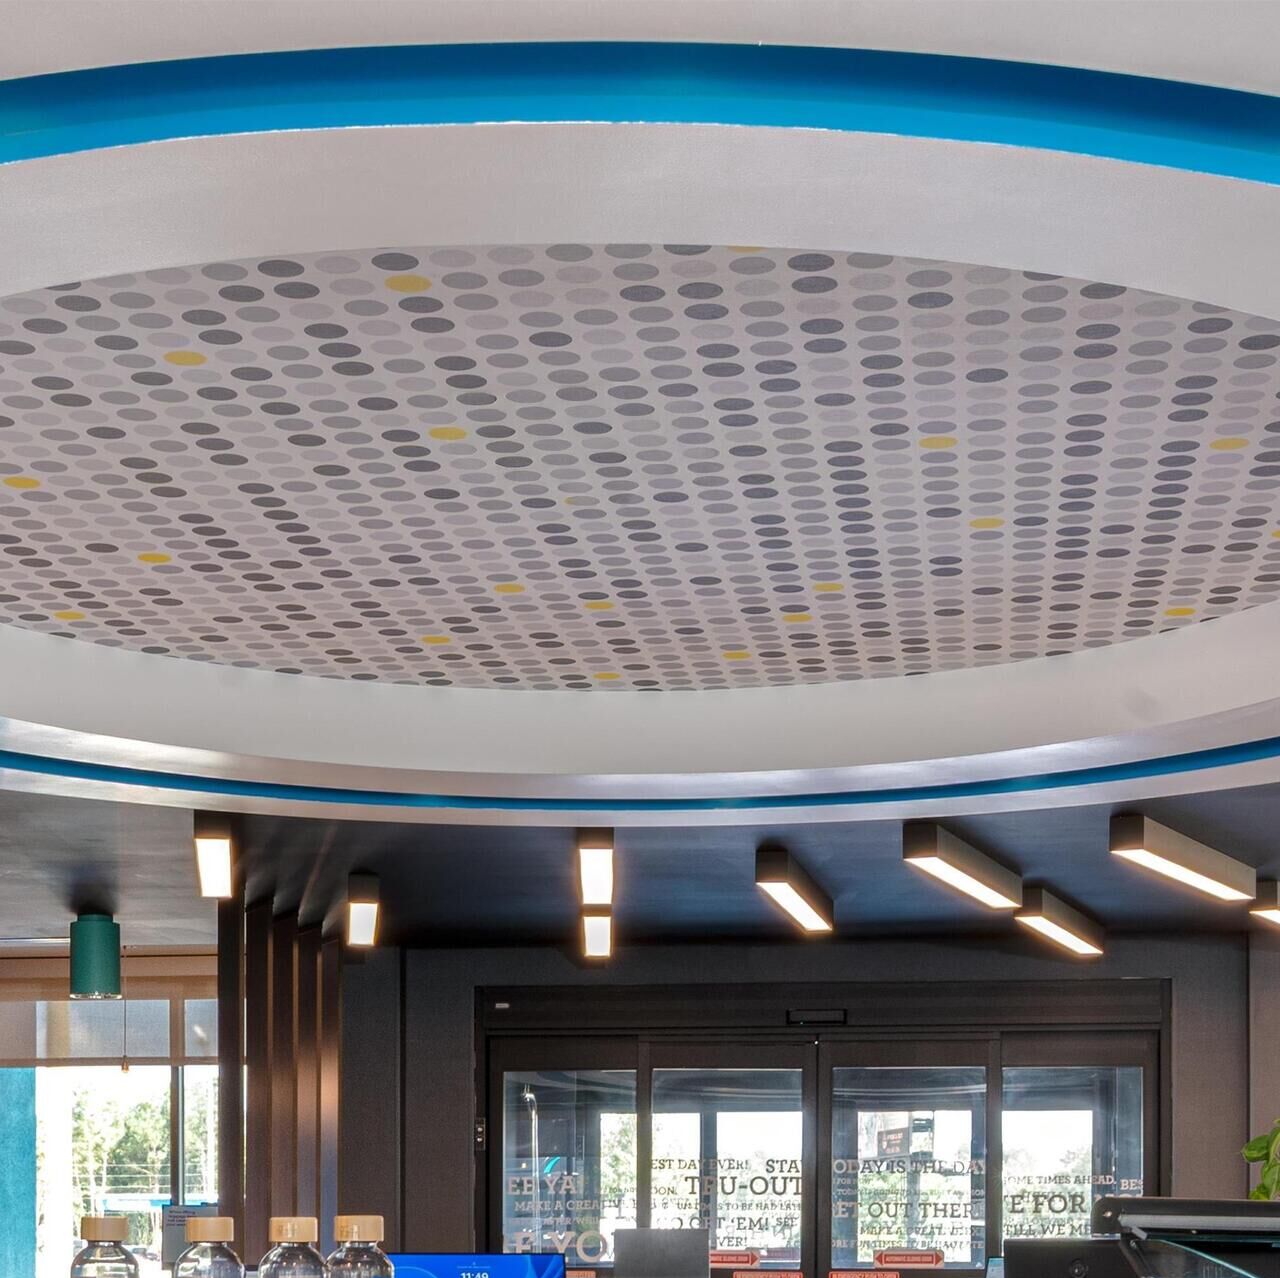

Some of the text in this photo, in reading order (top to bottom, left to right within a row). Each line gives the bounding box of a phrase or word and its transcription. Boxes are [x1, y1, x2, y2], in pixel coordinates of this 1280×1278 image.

[651, 1159, 673, 1169] EST
[765, 1159, 801, 1173] STA
[833, 1160, 886, 1174] ODAY
[1004, 1176, 1034, 1185] OME
[1120, 1179, 1143, 1190] BES
[1032, 1194, 1087, 1213] FOR
[833, 1202, 862, 1218] ET
[868, 1202, 912, 1218] OUT
[718, 1237, 748, 1247] VER!
